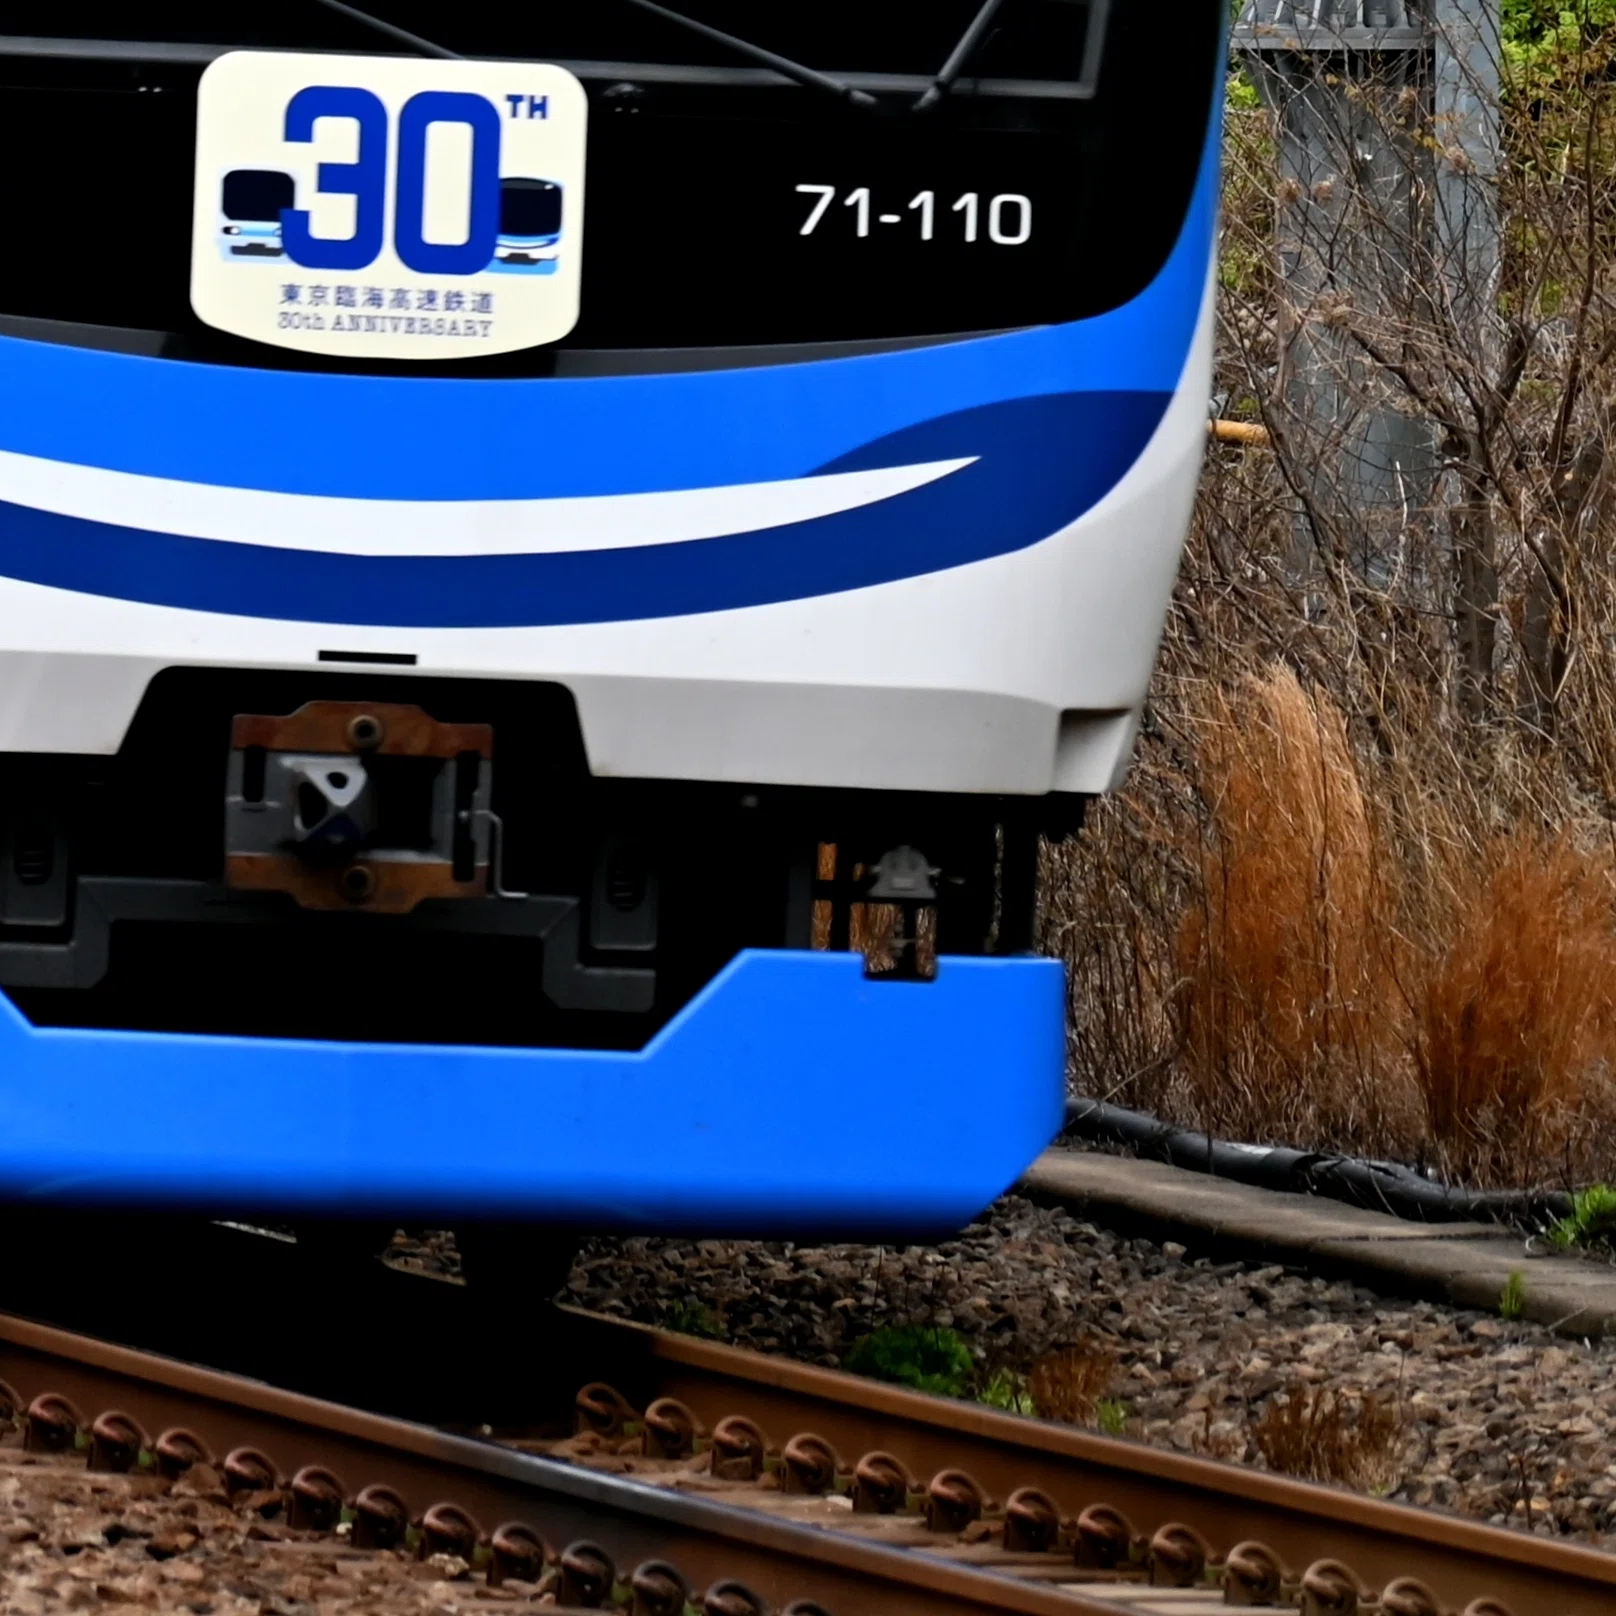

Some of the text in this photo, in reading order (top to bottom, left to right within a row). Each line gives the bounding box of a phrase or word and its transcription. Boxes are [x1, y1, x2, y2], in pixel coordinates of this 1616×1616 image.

[794, 183, 1033, 246] 71-110
[278, 283, 496, 315] 東京臨海高速鉄道
[330, 313, 494, 338] ANNIVERSARY
